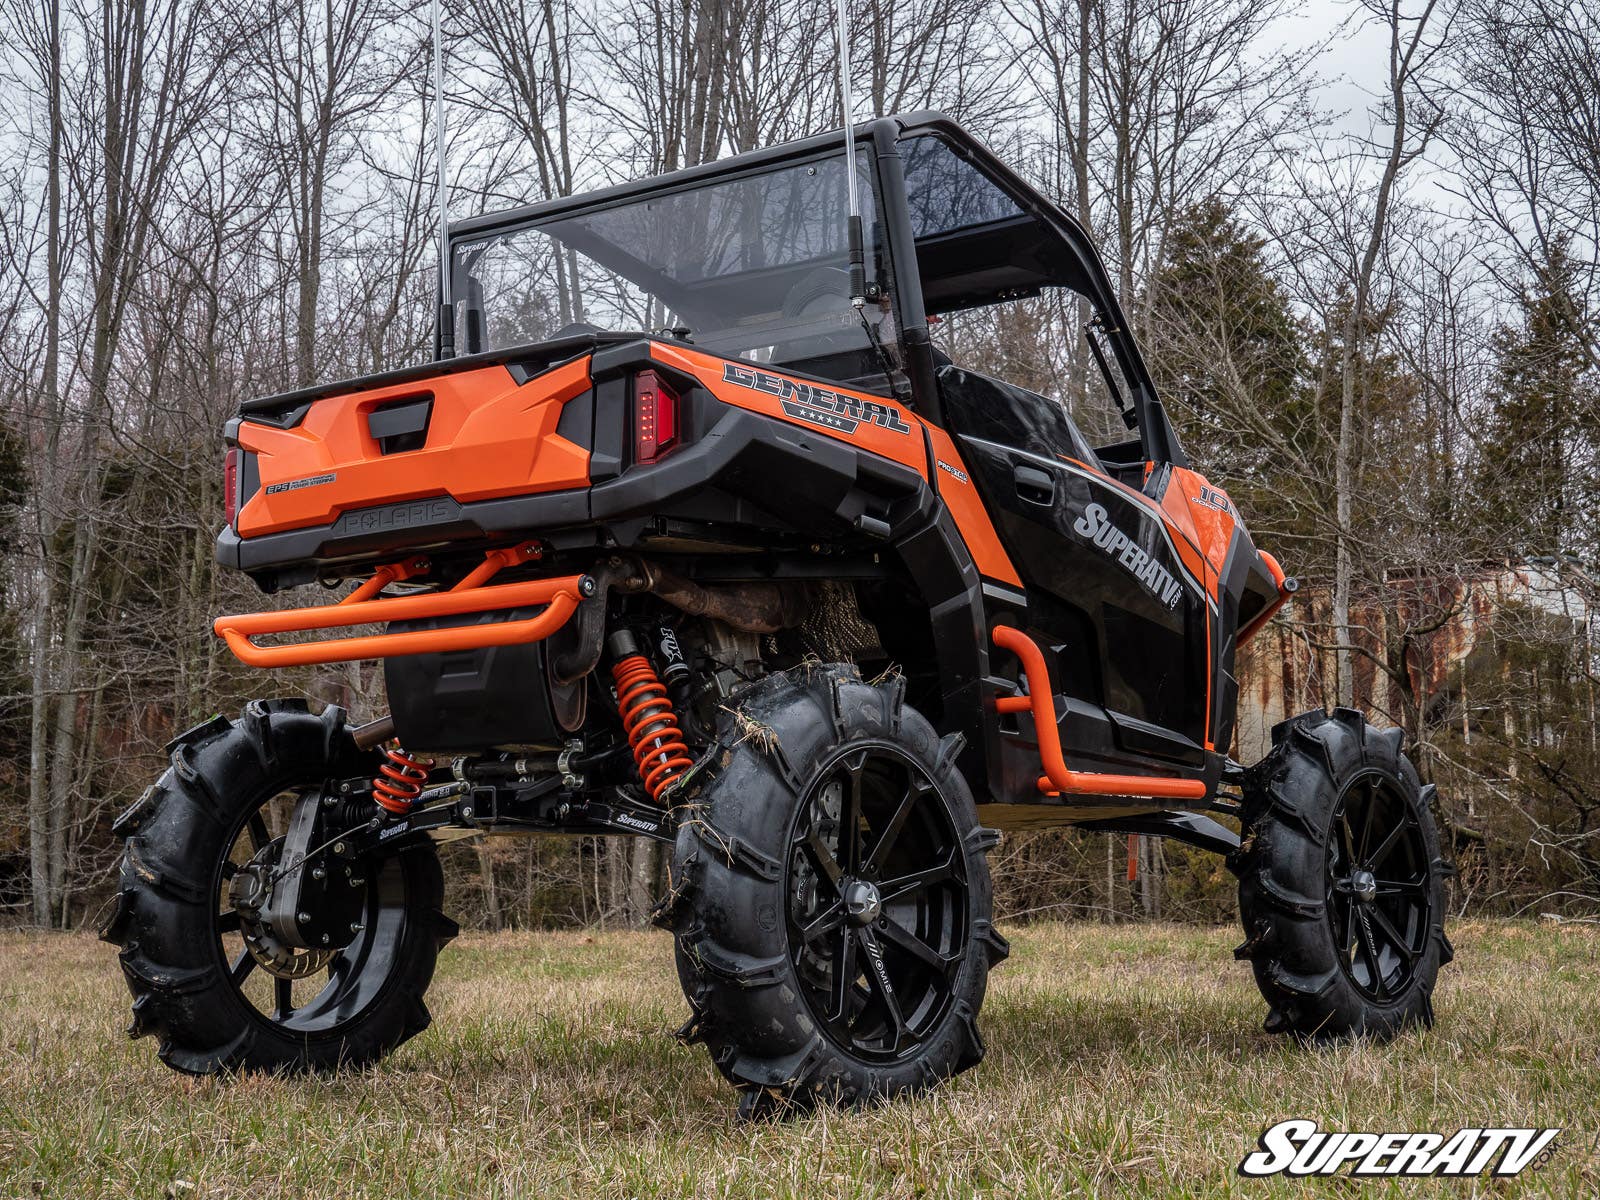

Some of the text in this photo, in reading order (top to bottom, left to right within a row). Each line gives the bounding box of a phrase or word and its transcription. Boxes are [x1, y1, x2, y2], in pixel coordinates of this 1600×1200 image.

[722, 362, 911, 435] GENERAL
[266, 482, 289, 494] EPS
[344, 500, 450, 533] POLARIS
[660, 627, 683, 662] FOX
